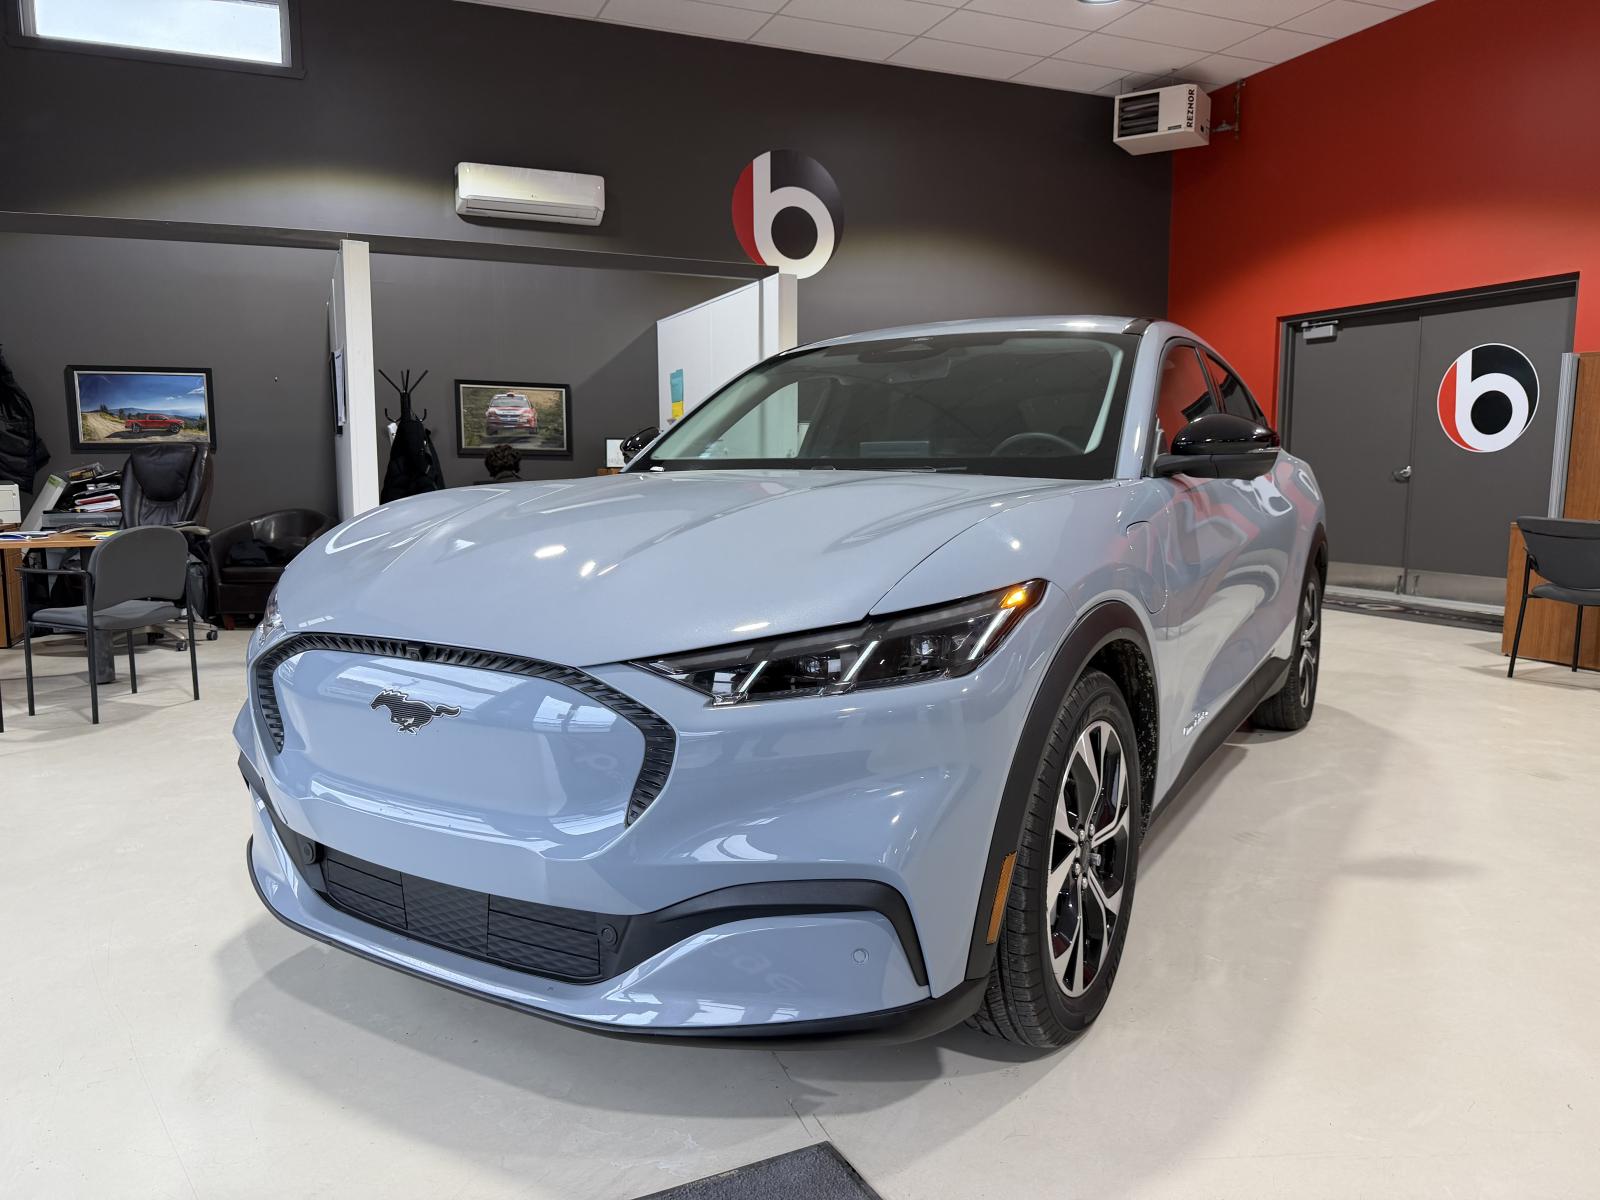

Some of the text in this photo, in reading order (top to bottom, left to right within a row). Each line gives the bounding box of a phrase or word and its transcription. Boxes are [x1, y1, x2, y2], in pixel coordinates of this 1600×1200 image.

[1186, 89, 1195, 128] REZNOR
[753, 151, 835, 279] b
[1455, 349, 1528, 452] b
